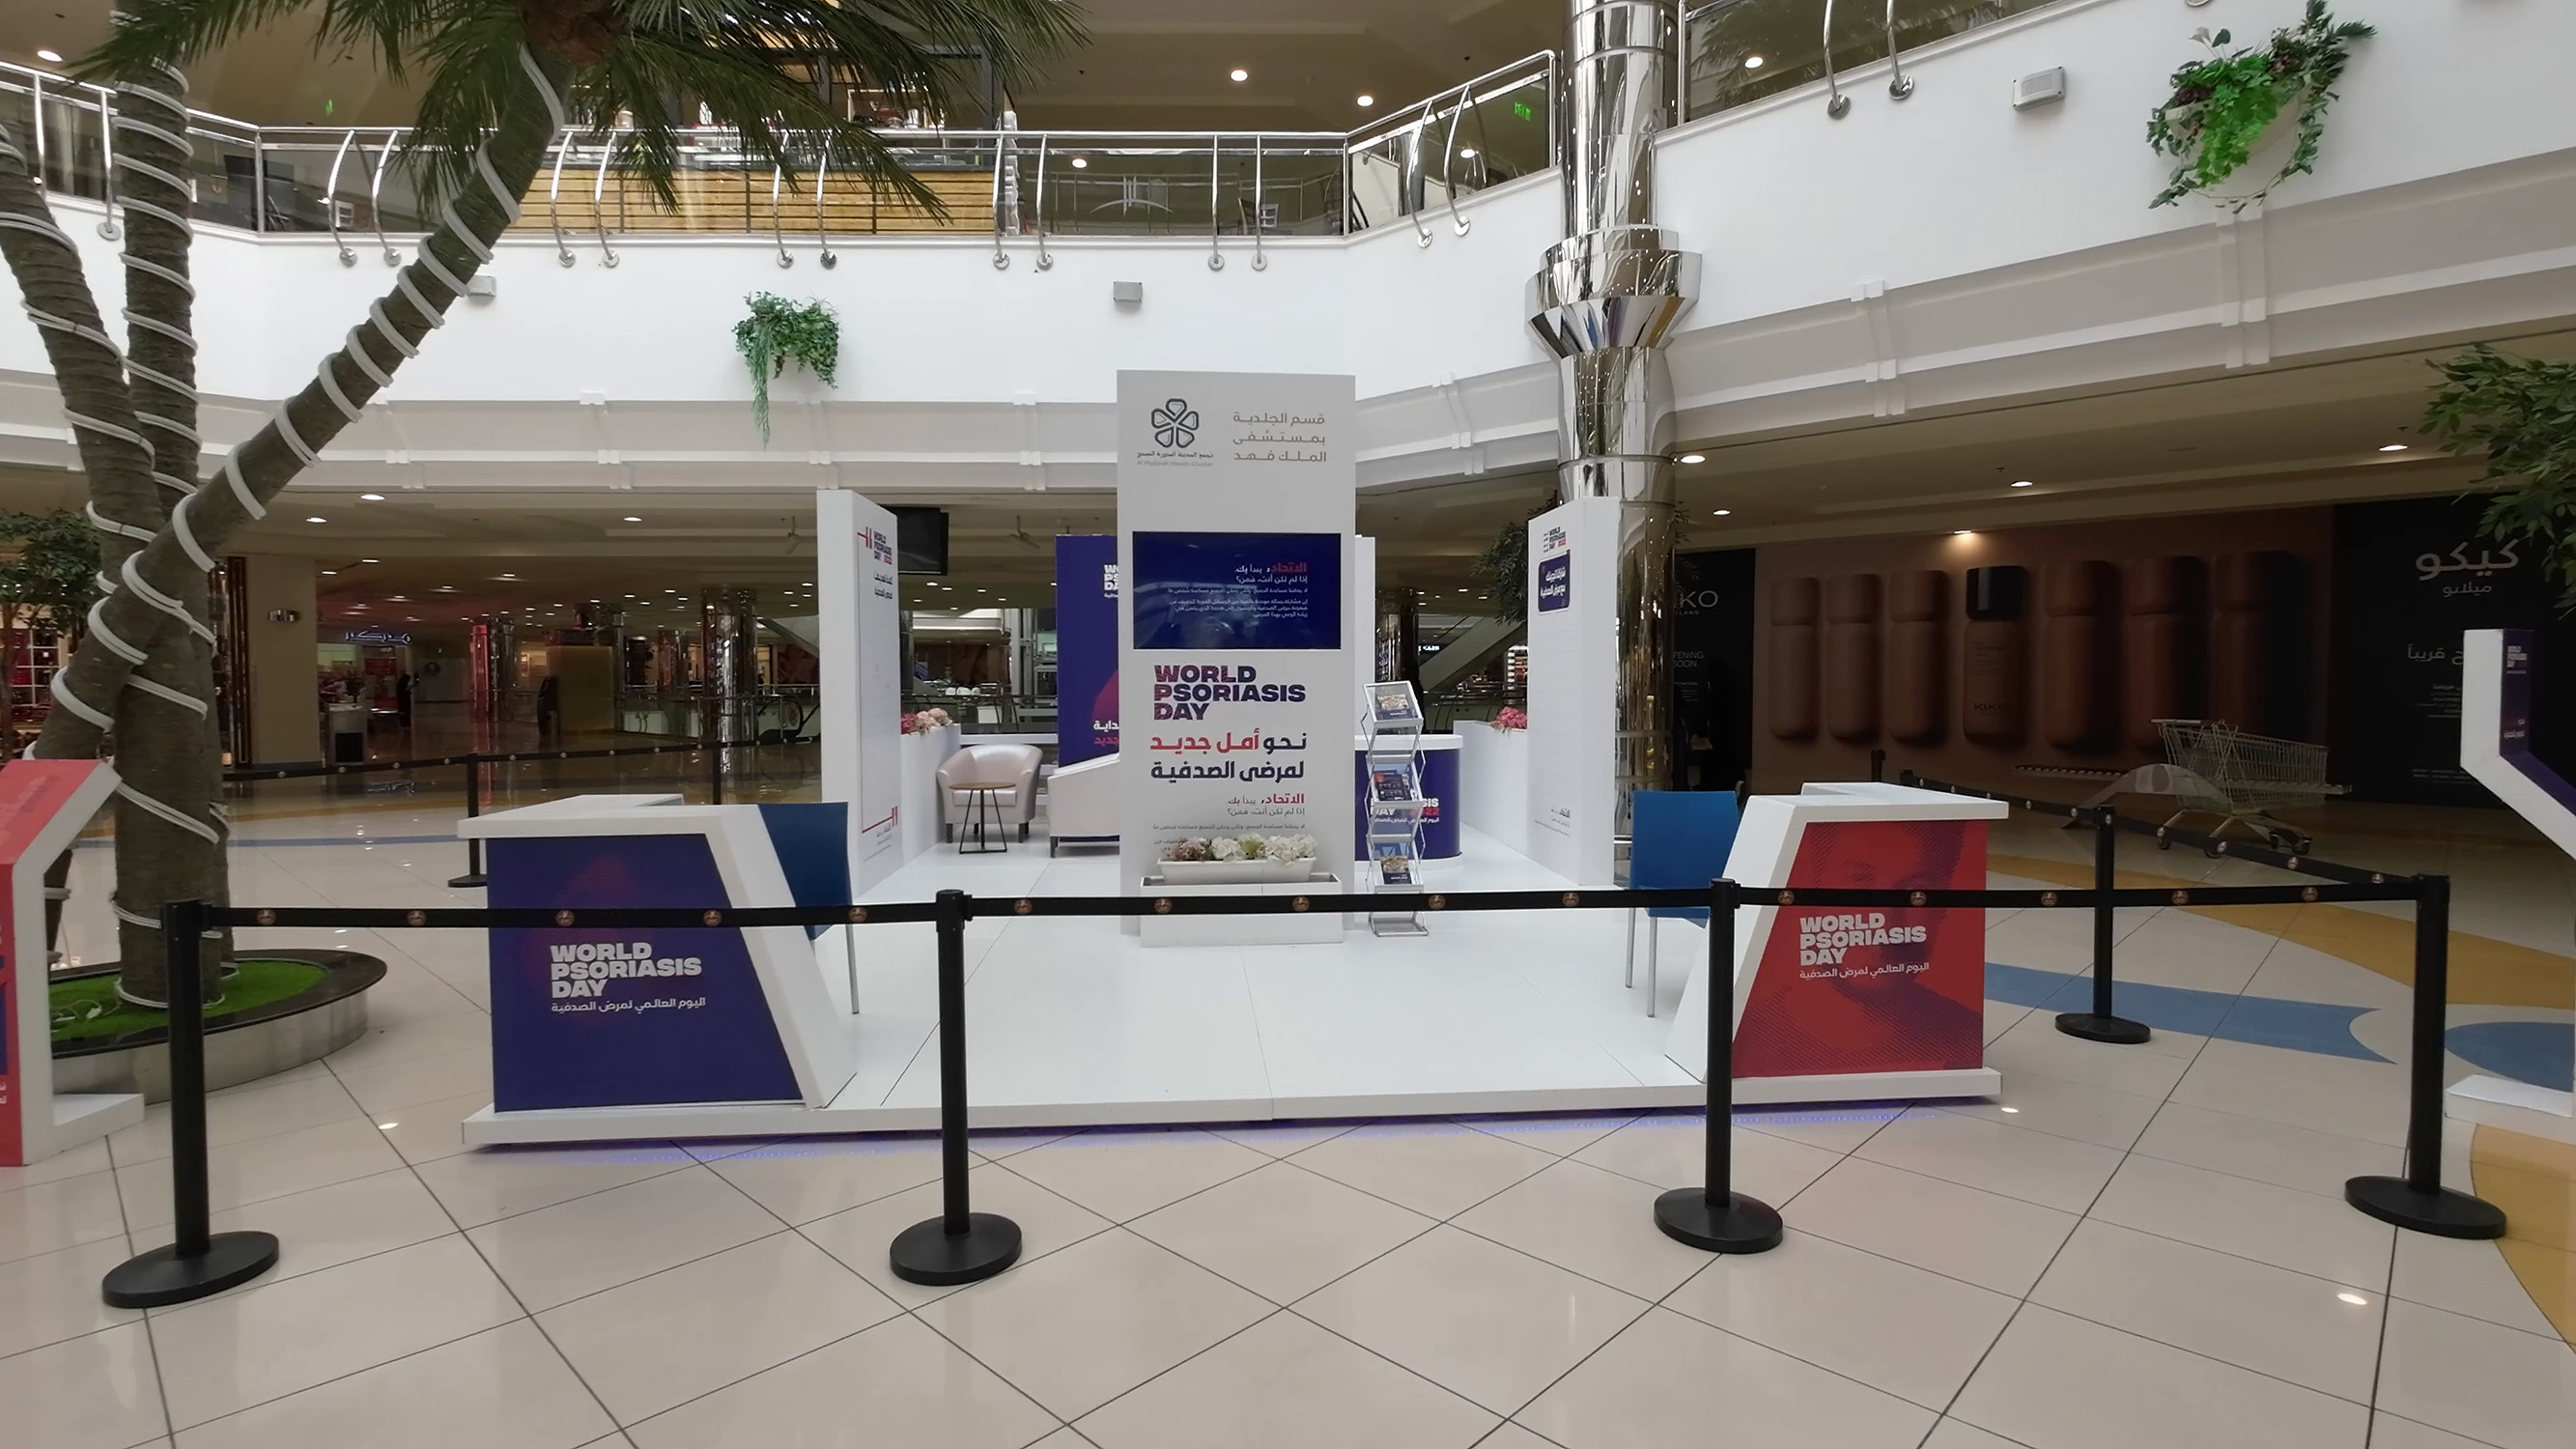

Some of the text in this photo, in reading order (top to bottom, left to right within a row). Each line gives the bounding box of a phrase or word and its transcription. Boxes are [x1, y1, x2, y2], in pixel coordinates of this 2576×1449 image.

[1232, 412, 1325, 428] قسم الجلدية
[1232, 429, 1325, 445] بمستشفى
[1233, 450, 1327, 463] الملك فهد
[2415, 538, 2519, 582] كيكو
[2442, 581, 2493, 598] ميلانو
[1674, 590, 1718, 609] KO
[1673, 650, 1705, 660] PENING
[1154, 665, 1257, 682] WORLD
[1154, 683, 1306, 703] PSORIASIS
[1154, 702, 1209, 721] DAY
[1093, 720, 1119, 732] داية
[1150, 727, 1307, 755] نحو أمل جديد
[1150, 760, 1304, 783] لمرضى الصدفية
[1228, 797, 1240, 806] بك
[1242, 795, 1256, 806] يبدأ
[1269, 808, 1283, 816] تكن
[1285, 808, 1294, 817] لم
[1296, 807, 1306, 816] إذا
[1799, 913, 1884, 933] WORLD
[1799, 925, 1927, 950] PSORIASIS
[550, 942, 652, 963] WORLD
[1799, 948, 1848, 966] DAY
[551, 957, 702, 980] PSORIASIS
[1799, 962, 1930, 981] اليوم العالمي لمرض الصدفية
[551, 980, 609, 999] DAY
[551, 996, 706, 1014] اليوم العالمي لمرض الصدفية
